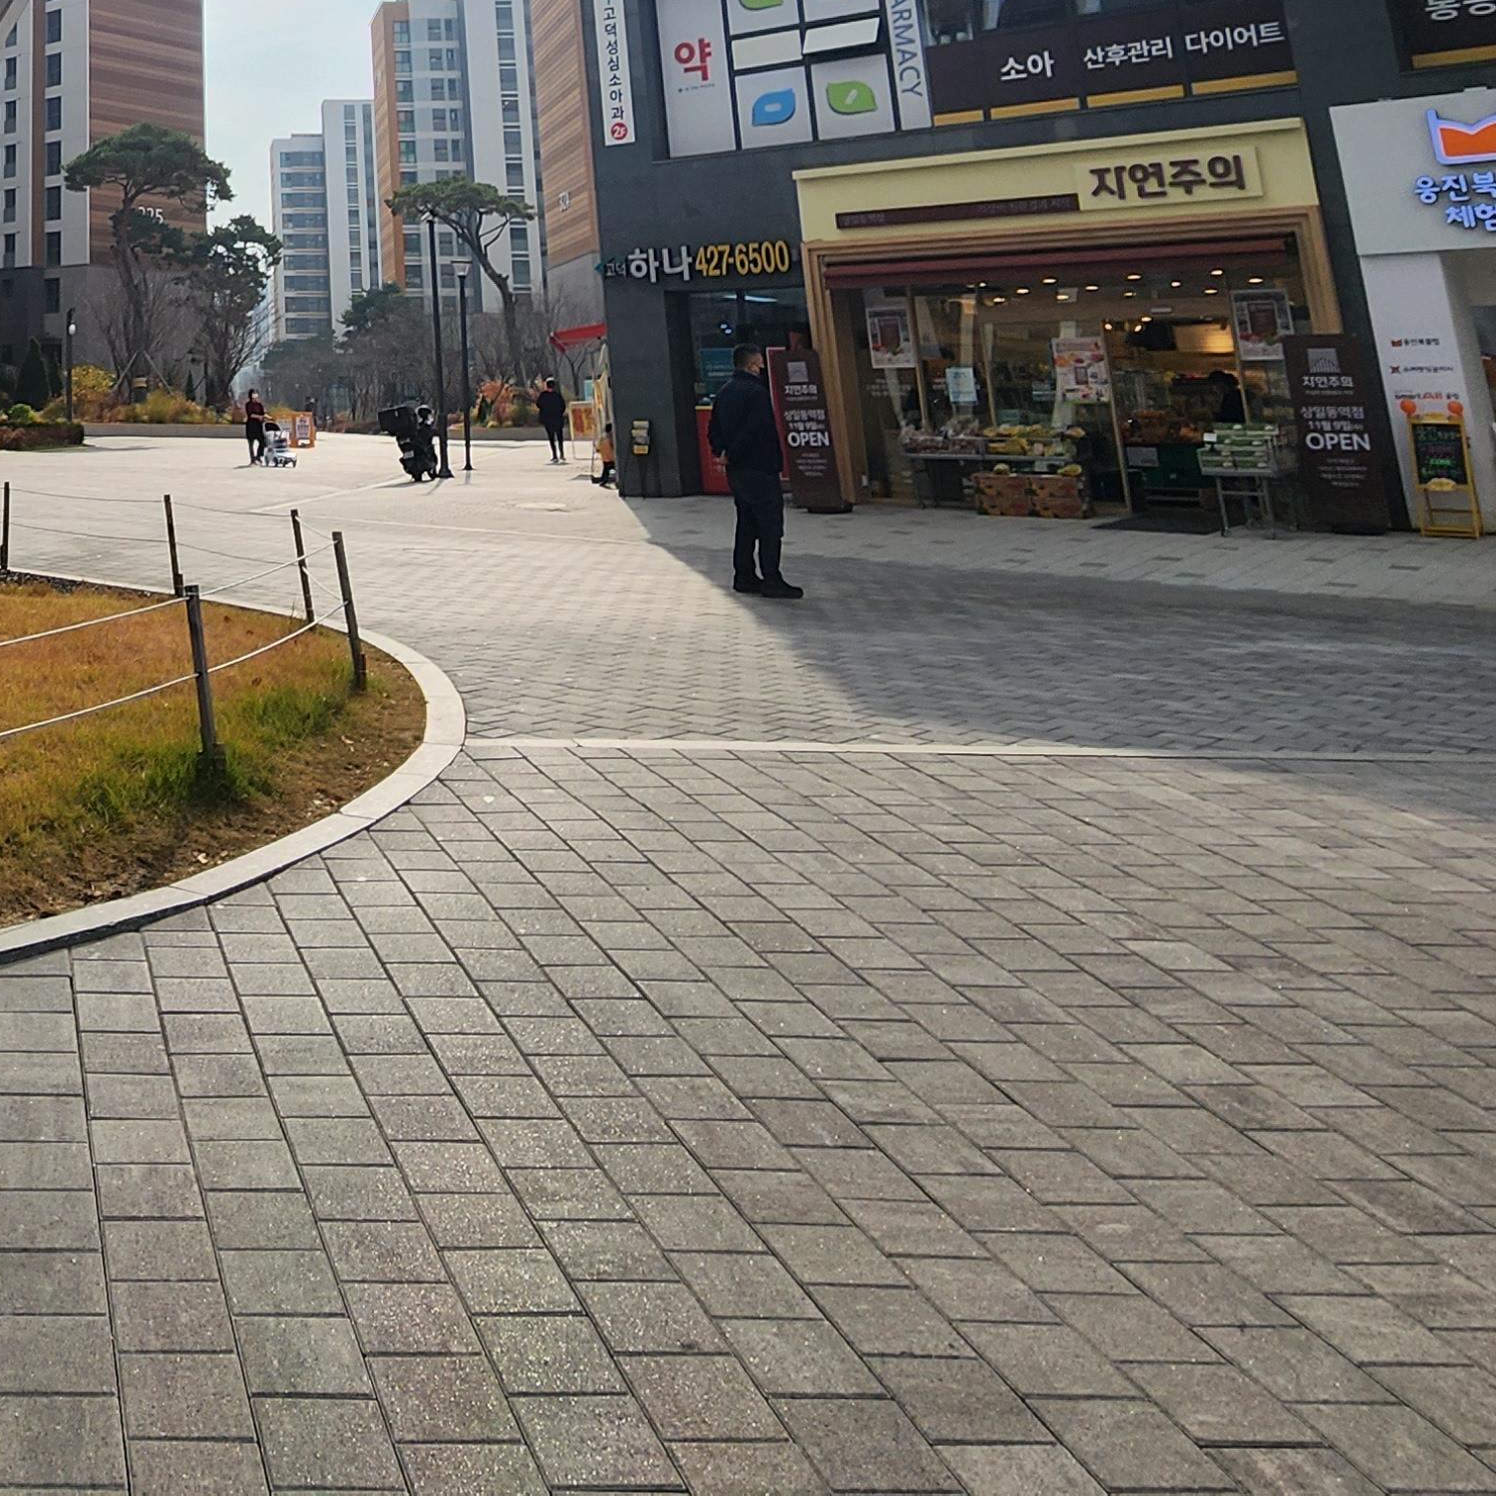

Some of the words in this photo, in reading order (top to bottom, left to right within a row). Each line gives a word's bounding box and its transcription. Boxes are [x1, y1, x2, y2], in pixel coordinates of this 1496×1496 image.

[674, 37, 712, 82] 약
[1000, 50, 1054, 82] 소아
[1083, 36, 1173, 70] 산후관리
[1184, 21, 1285, 55] 다이어트
[628, 245, 692, 283] 하나
[694, 240, 790, 277] 427-6500
[787, 431, 830, 447] OPEN
[1305, 432, 1371, 451] OPEN
